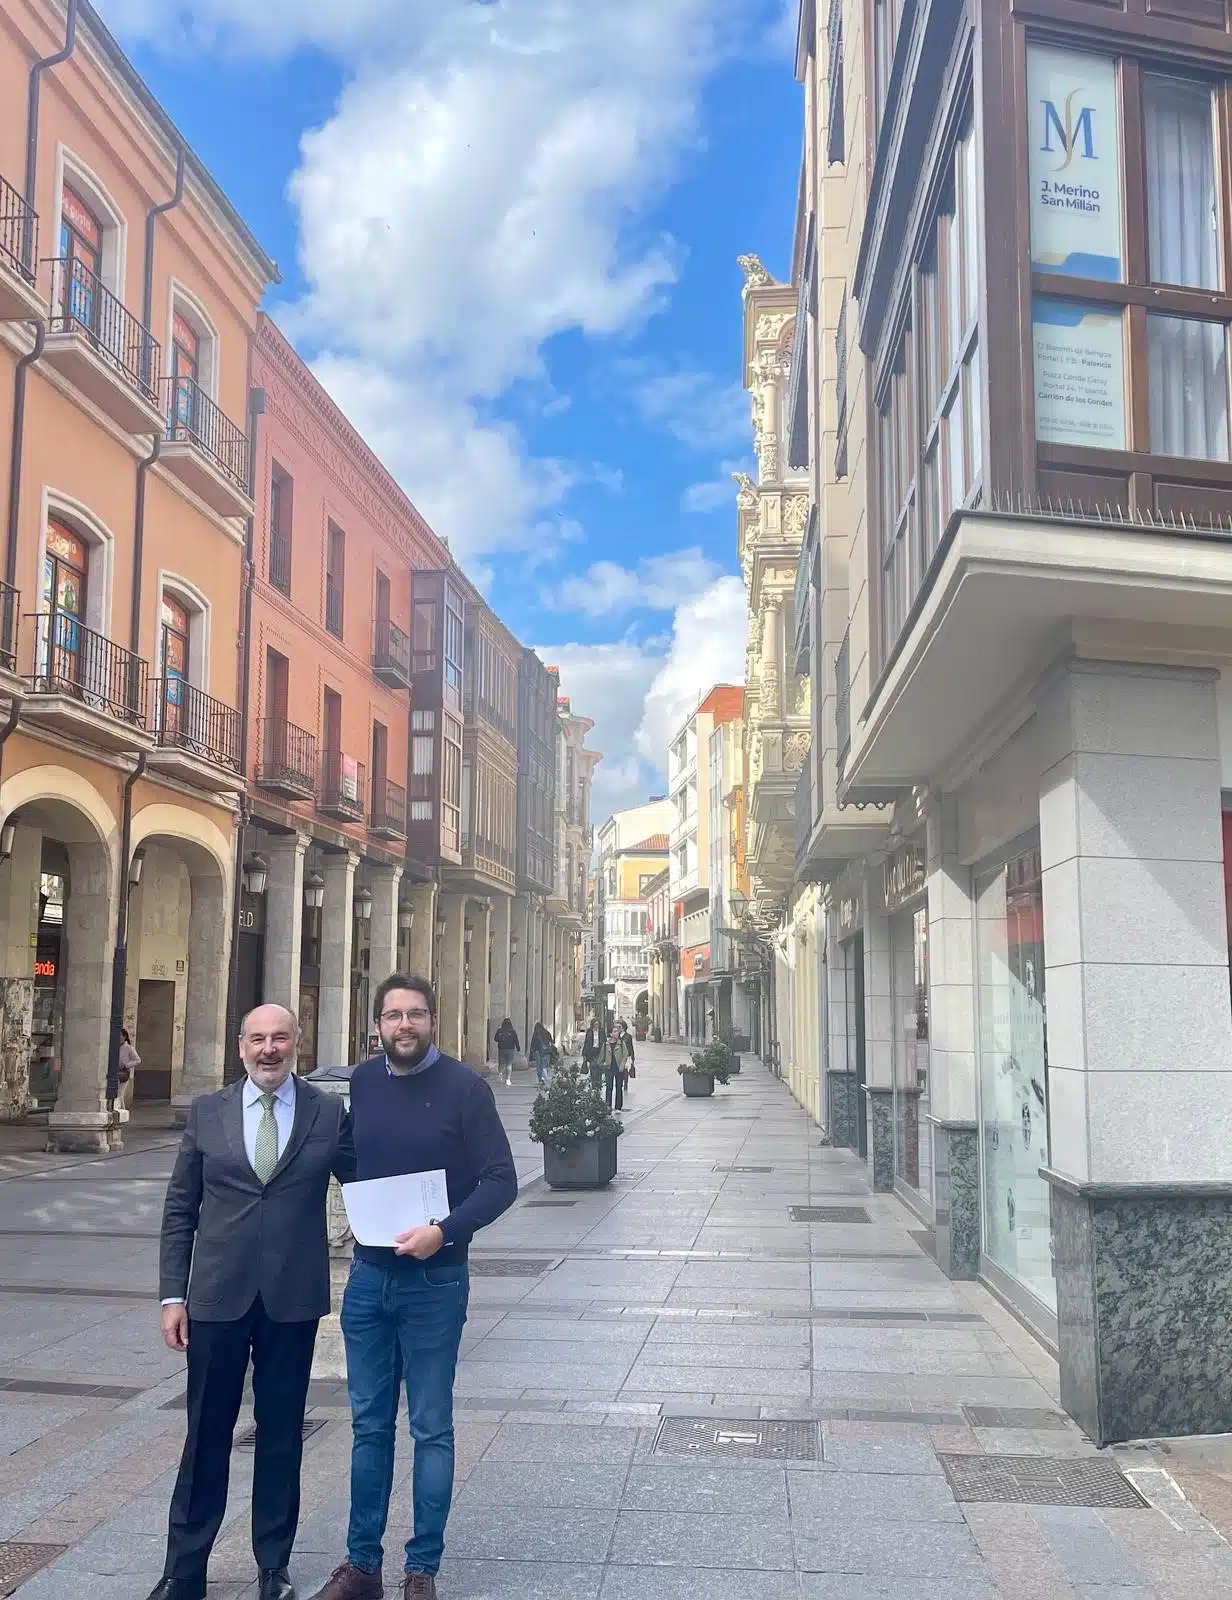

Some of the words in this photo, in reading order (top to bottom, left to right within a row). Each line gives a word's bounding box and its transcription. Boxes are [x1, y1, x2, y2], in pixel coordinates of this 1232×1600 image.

[1041, 180, 1052, 193] J.
[1054, 182, 1100, 200] Merino
[1041, 194, 1065, 207] San
[1066, 197, 1101, 213] Millán
[1081, 359, 1112, 369] Palencia
[1065, 394, 1075, 403] de
[1075, 396, 1086, 404] los
[1087, 397, 1113, 408] Condes
